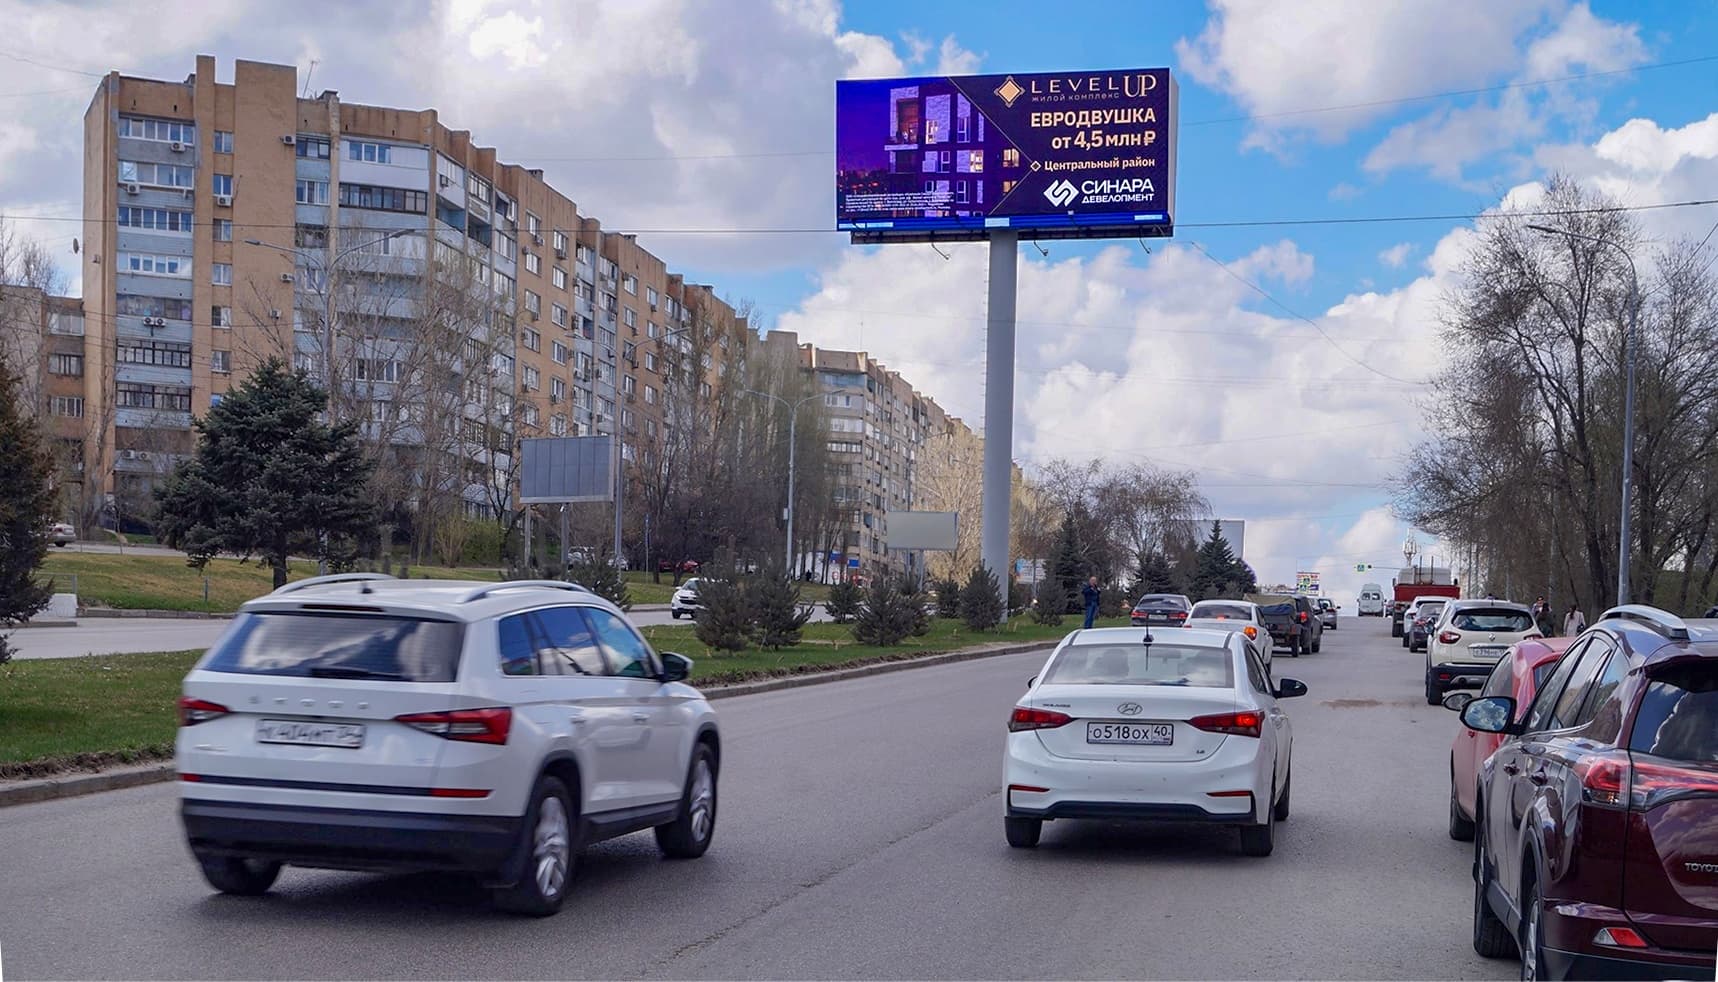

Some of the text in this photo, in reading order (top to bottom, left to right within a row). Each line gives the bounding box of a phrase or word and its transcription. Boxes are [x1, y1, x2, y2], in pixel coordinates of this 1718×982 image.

[1031, 74, 1157, 98] LEVEL UP
[1031, 92, 1120, 102] жилой комплекс
[1031, 107, 1156, 129] ЕВРОДВУШКА
[1051, 137, 1072, 149] от
[1074, 130, 1103, 150] 4,5
[1044, 156, 1155, 171] Центральный район
[1081, 178, 1155, 194] СИНАРА
[1081, 193, 1155, 204] ДЕВЕЛОПМЕНТ
[1153, 726, 1168, 736] 40
